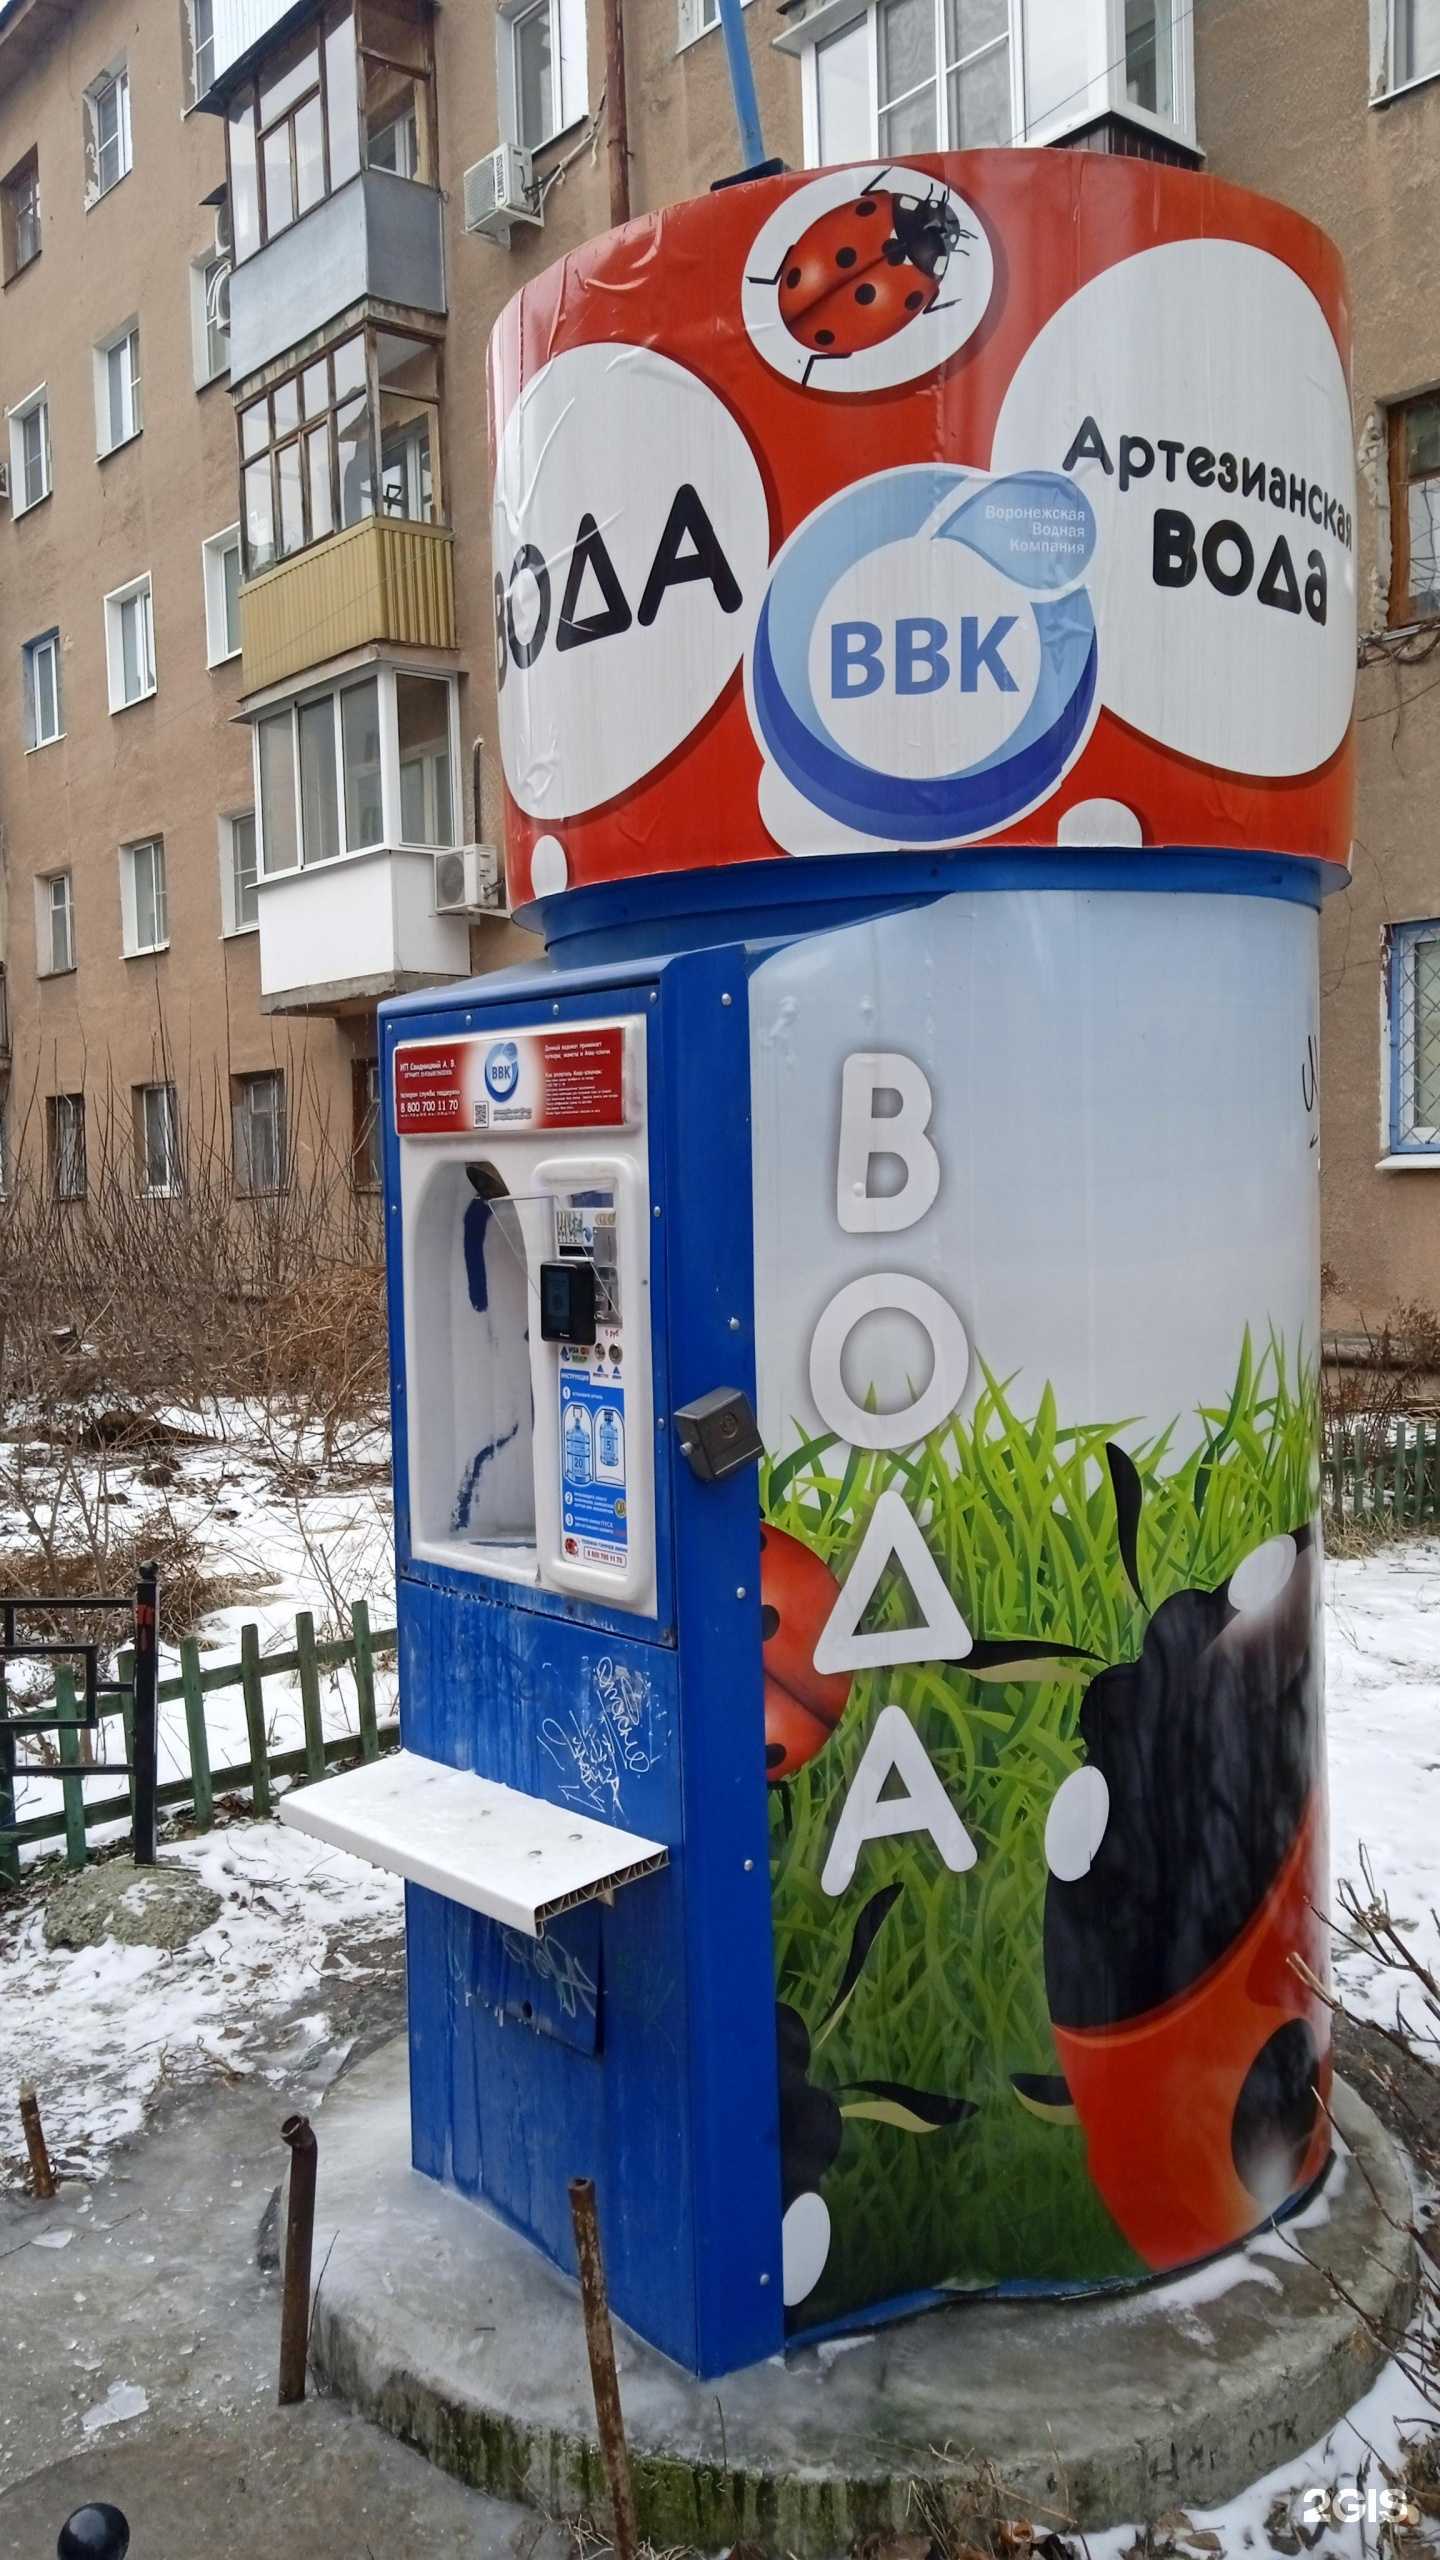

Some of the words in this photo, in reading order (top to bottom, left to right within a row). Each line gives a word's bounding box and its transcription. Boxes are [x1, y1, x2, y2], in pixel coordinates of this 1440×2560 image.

[985, 505, 1085, 522] Воронежская
[1032, 522, 1085, 537] Водная
[1010, 539, 1085, 554] Компания
[831, 616, 1020, 699] ВВК
[401, 1103, 405, 1113] 8
[407, 1101, 420, 1113] 800
[422, 1101, 435, 1112] 700
[438, 1100, 446, 1111] 11
[449, 1099, 459, 1111] 70
[810, 1052, 979, 1897] ВОДА
